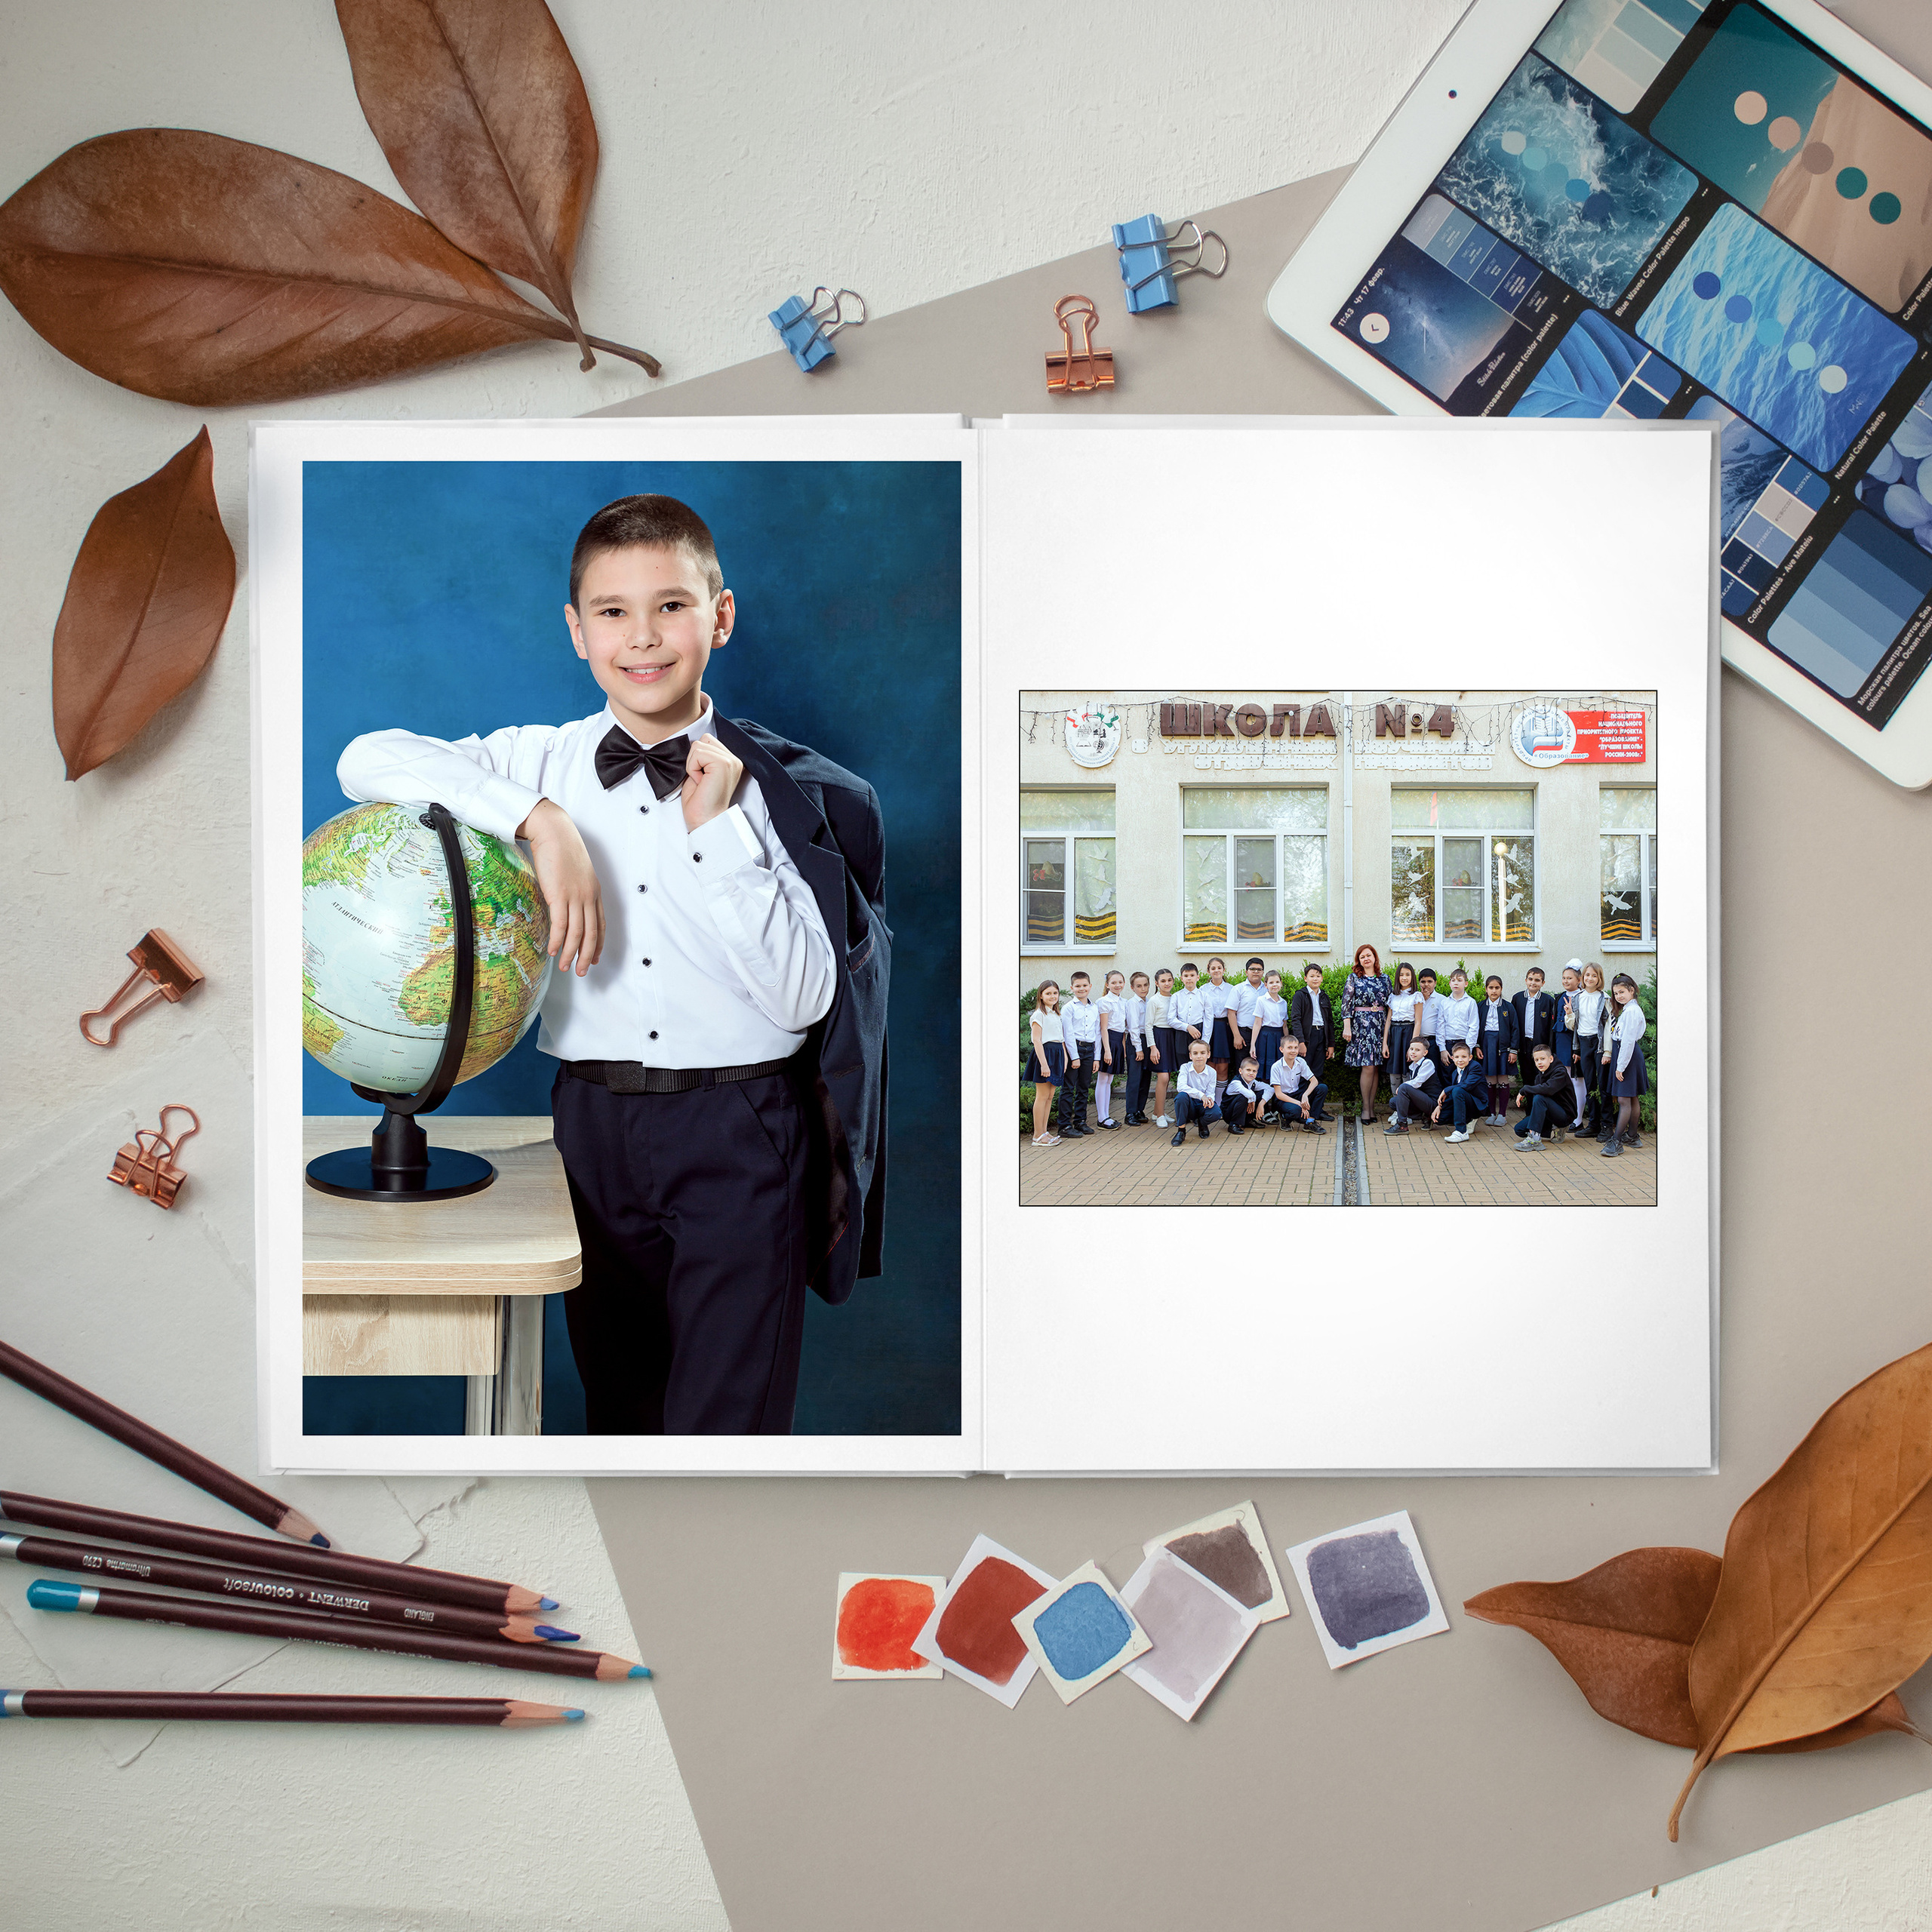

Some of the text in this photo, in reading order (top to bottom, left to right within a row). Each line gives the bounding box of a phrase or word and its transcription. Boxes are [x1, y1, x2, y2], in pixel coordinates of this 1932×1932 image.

[1361, 285, 1370, 295] 17
[1367, 267, 1386, 287] февр.
[1615, 300, 1629, 317] Blue
[1626, 278, 1645, 301] Waves
[1642, 259, 1659, 278] Color
[1656, 235, 1676, 260] Palette
[1673, 216, 1690, 236] Inspo
[1337, 308, 1355, 327] 11:43
[1903, 301, 1918, 321] Color
[1478, 389, 1503, 417] ветовая
[1500, 361, 1524, 391] палитра
[1521, 340, 1538, 362] (color
[1536, 313, 1559, 343] palette)
[1834, 453, 1857, 480] Natural
[1853, 435, 1869, 454] Color
[1866, 411, 1887, 436] Palette
[1747, 606, 1764, 624] Color
[1761, 577, 1783, 605] Palettes
[1783, 559, 1796, 574] Ave
[1857, 605, 1932, 706] Морская палитра цветов. Sea
[1866, 685, 1887, 712] colours
[1884, 661, 1906, 688] palette.
[1902, 636, 1921, 660] Ocean
[1159, 703, 1337, 737] ШКОЛА
[82, 1554, 103, 1568] C290
[223, 1577, 370, 1611] DERWENT coloursoft
[404, 1607, 435, 1622] ENGLAND
